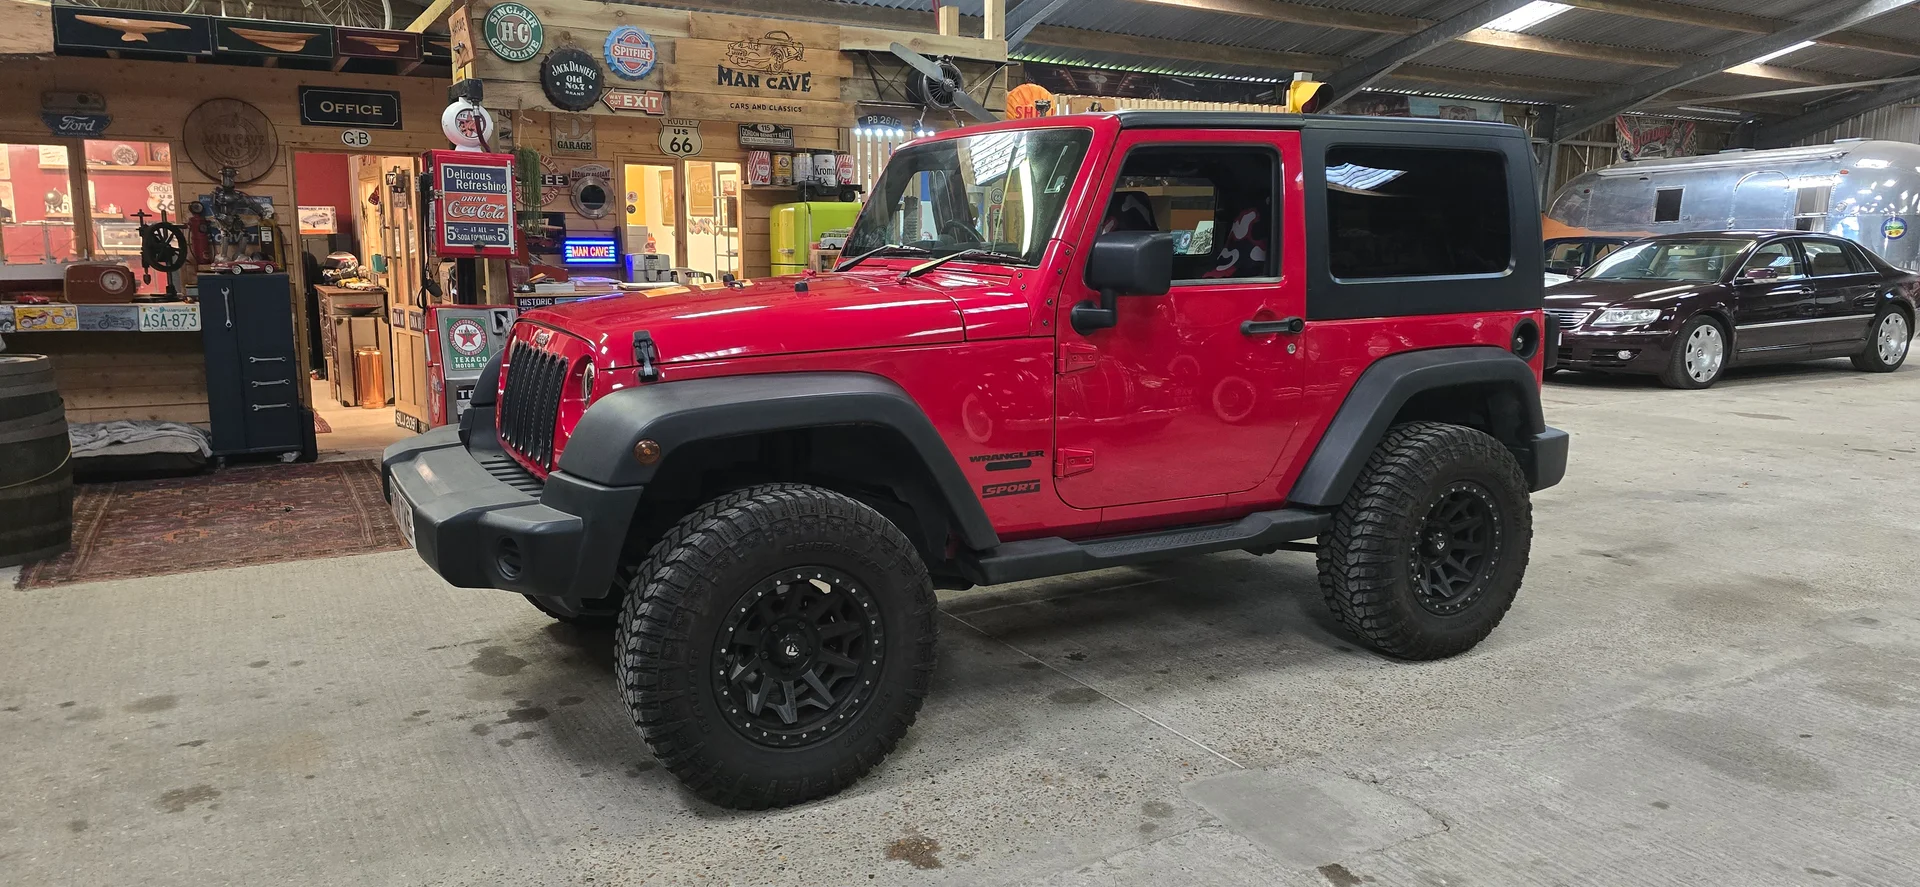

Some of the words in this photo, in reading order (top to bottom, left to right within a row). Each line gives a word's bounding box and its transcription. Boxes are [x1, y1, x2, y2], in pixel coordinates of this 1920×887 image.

[490, 3, 538, 28] SINCLAIR
[490, 37, 540, 59] GASOLINE
[614, 45, 651, 60] SPITFIRE
[551, 62, 570, 77] JACK
[566, 75, 583, 84] Old
[717, 65, 760, 88] MAN
[766, 72, 812, 93] CAVE
[565, 82, 585, 90] No.7
[320, 100, 383, 116] OFFICE
[623, 95, 659, 108] EXIT
[730, 102, 750, 110] CARS
[752, 103, 767, 111] AND
[768, 104, 802, 113] CLASSICS
[58, 115, 96, 132] Ford
[761, 124, 771, 132] 115
[342, 131, 369, 145] GB
[673, 128, 689, 136] US
[557, 140, 592, 150] GARAGE
[669, 137, 693, 153] 66
[1632, 124, 1673, 155] Garage
[446, 167, 492, 181] Delicious
[456, 180, 507, 194] Refreshing
[157, 199, 175, 212] 66
[460, 195, 488, 203] DRINK
[447, 201, 506, 219] Coca-Cola
[457, 233, 471, 241] SODA
[572, 246, 589, 257] MAN
[590, 246, 609, 257] CAVE
[520, 298, 553, 306] HISTORIC
[143, 313, 197, 328] ASA-873
[969, 450, 1045, 463] WRANGLER
[986, 482, 1037, 495] SPORT
